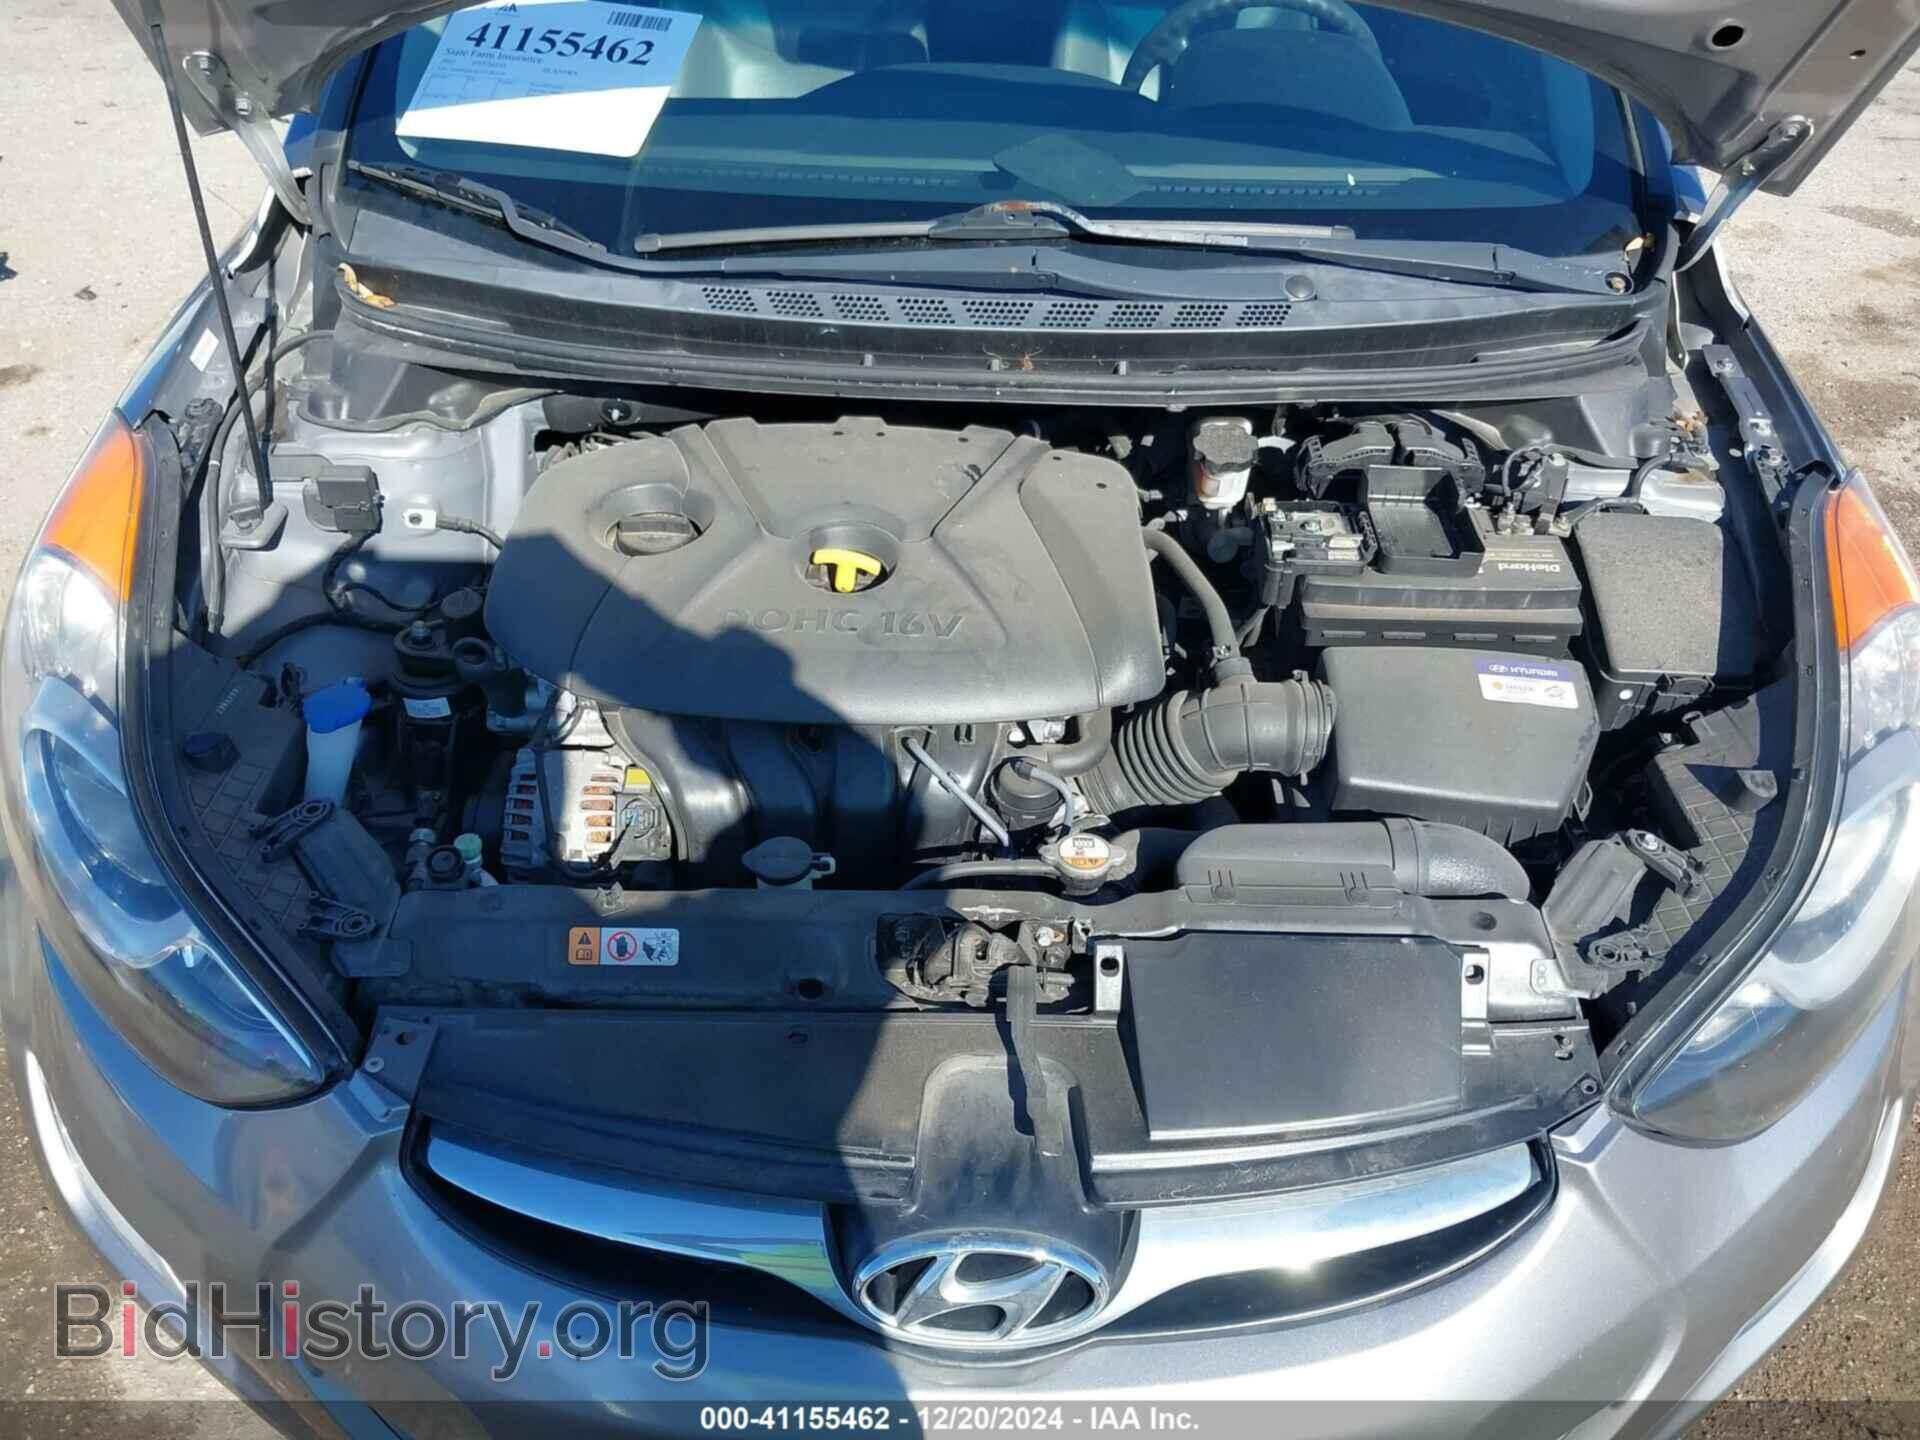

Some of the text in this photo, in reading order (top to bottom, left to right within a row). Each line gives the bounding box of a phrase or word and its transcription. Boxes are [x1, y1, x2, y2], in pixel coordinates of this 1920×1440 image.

[465, 21, 655, 66] 41155462
[1498, 562, 1561, 573] DieHard
[721, 607, 963, 638] DOHC 16V
